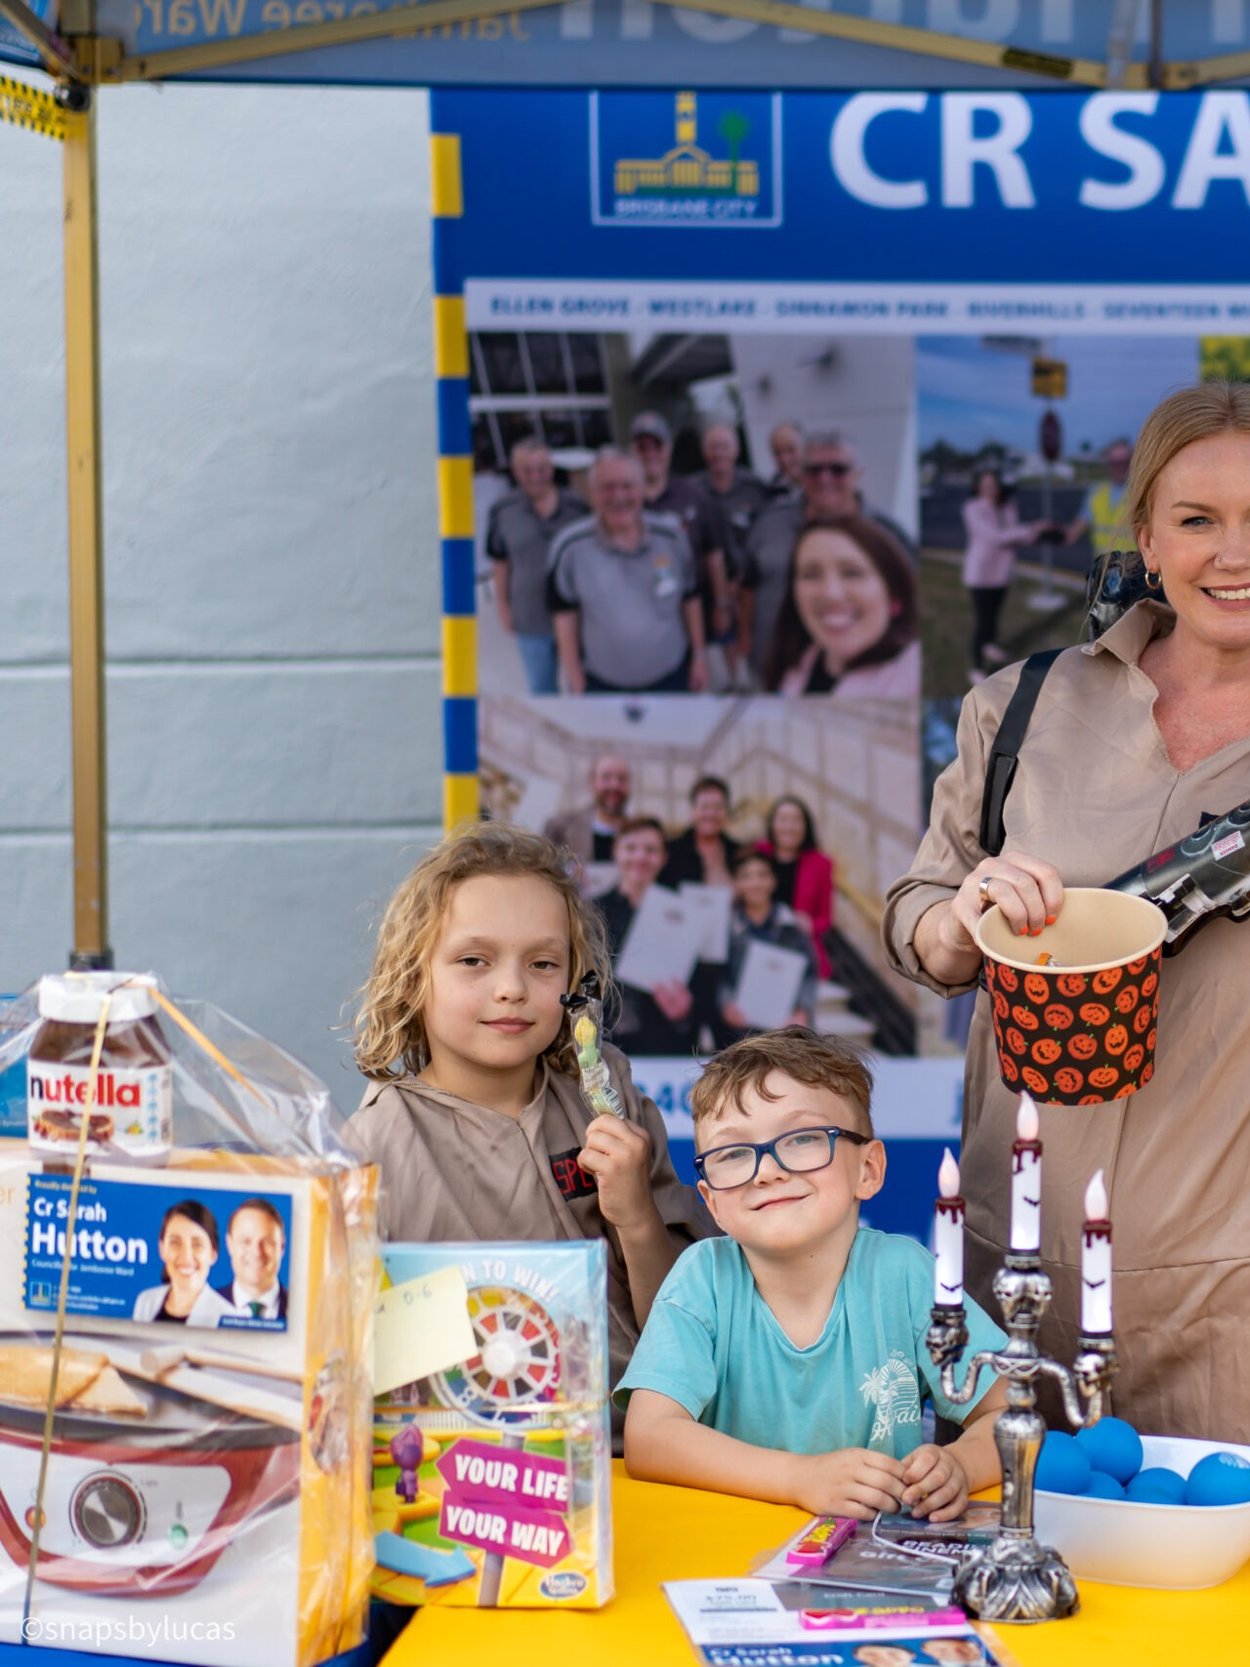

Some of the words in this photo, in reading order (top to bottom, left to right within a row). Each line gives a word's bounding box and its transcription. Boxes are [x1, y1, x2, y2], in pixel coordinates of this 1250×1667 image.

[828, 90, 1035, 209] CR
[490, 296, 554, 316] ELLEN
[560, 296, 631, 317] GROVE
[649, 297, 756, 317] WESTLAKE
[30, 1074, 141, 1107] nutella
[33, 1196, 54, 1218] Cr
[32, 1221, 149, 1265] Hutton
[482, 1259, 507, 1281] TO
[513, 1264, 560, 1304] WIN!
[455, 1453, 518, 1493] YOUR
[521, 1467, 569, 1502] LIFE
[446, 1505, 507, 1545] YOUR
[510, 1520, 565, 1557] WAY
